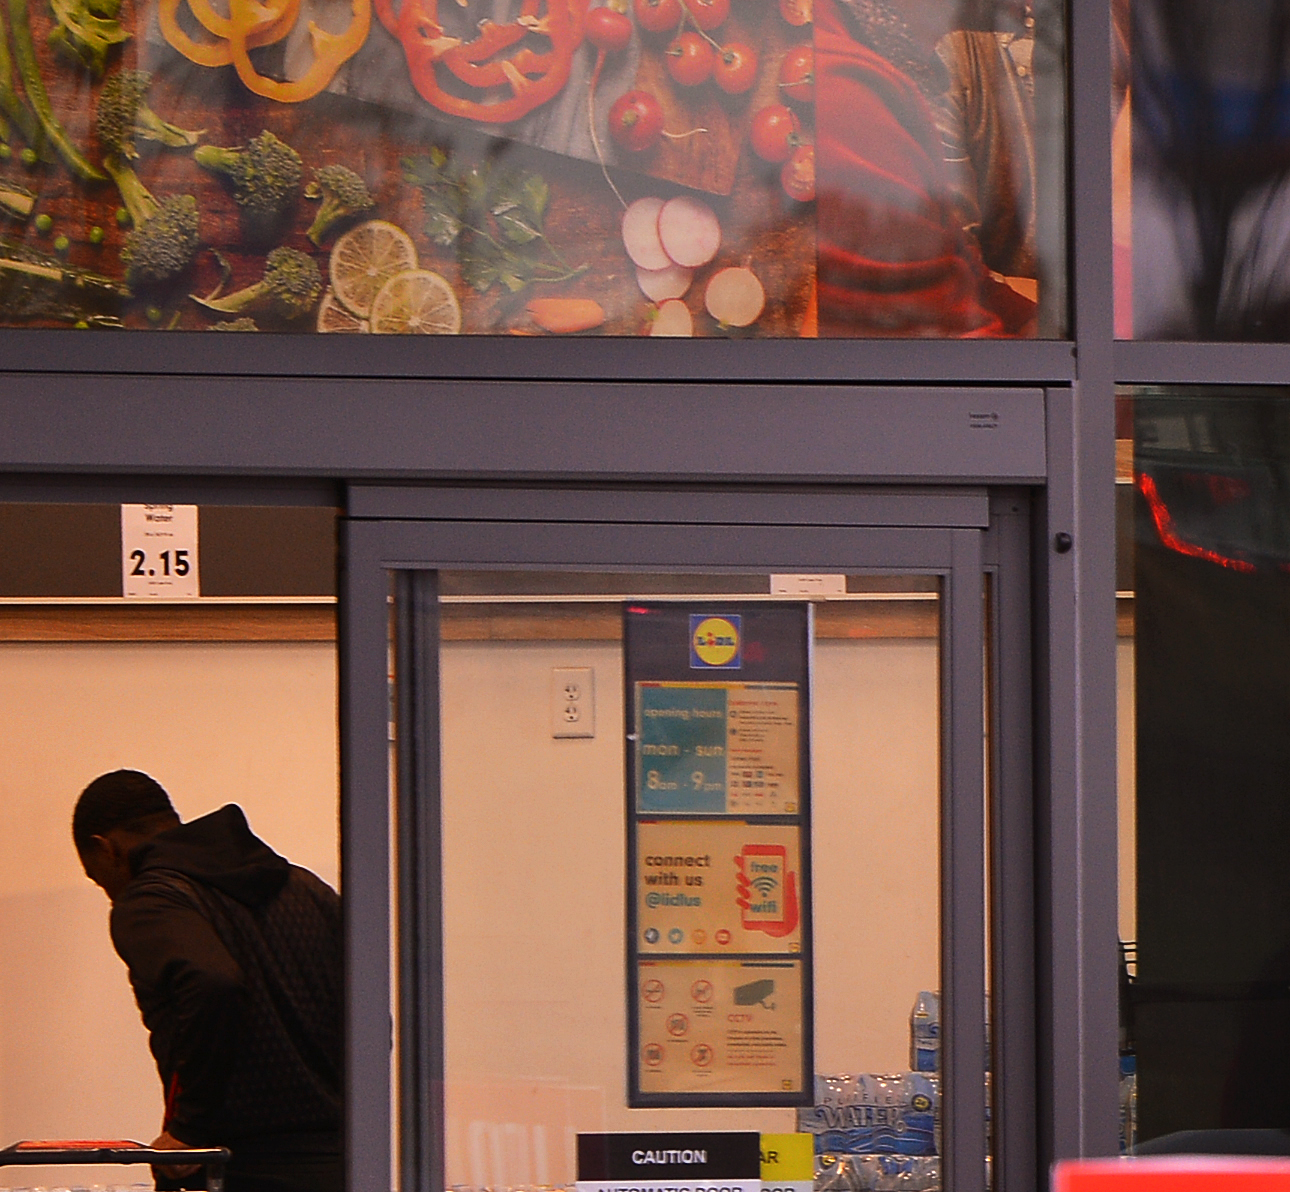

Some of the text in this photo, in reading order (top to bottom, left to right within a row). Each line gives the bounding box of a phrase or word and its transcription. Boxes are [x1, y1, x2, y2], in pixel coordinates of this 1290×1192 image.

[130, 550, 190, 577] 2.15
[644, 708, 723, 720] opening hours
[643, 744, 680, 756] mon
[695, 744, 725, 757] sun
[645, 854, 711, 867] connect
[750, 861, 778, 873] free
[645, 871, 703, 886] with us
[645, 892, 702, 908] @lidlus
[750, 900, 777, 913] wifi
[631, 1150, 707, 1165] CAUTION
